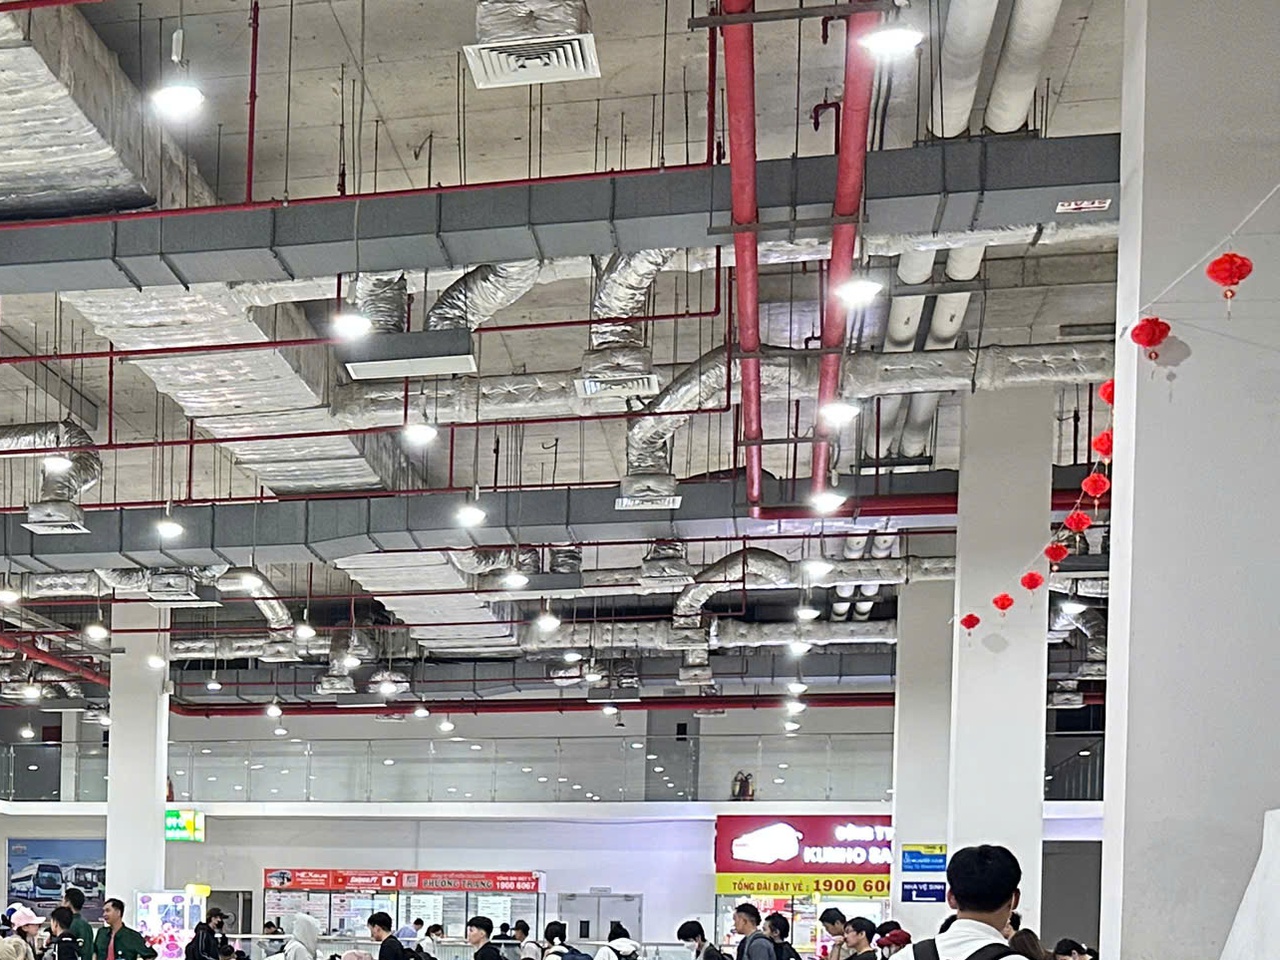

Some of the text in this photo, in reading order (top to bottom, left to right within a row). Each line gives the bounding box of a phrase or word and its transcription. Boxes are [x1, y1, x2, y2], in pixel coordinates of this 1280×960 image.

[803, 846, 867, 864] KUMHO
[496, 881, 515, 889] 1900
[813, 879, 856, 892] 1900
